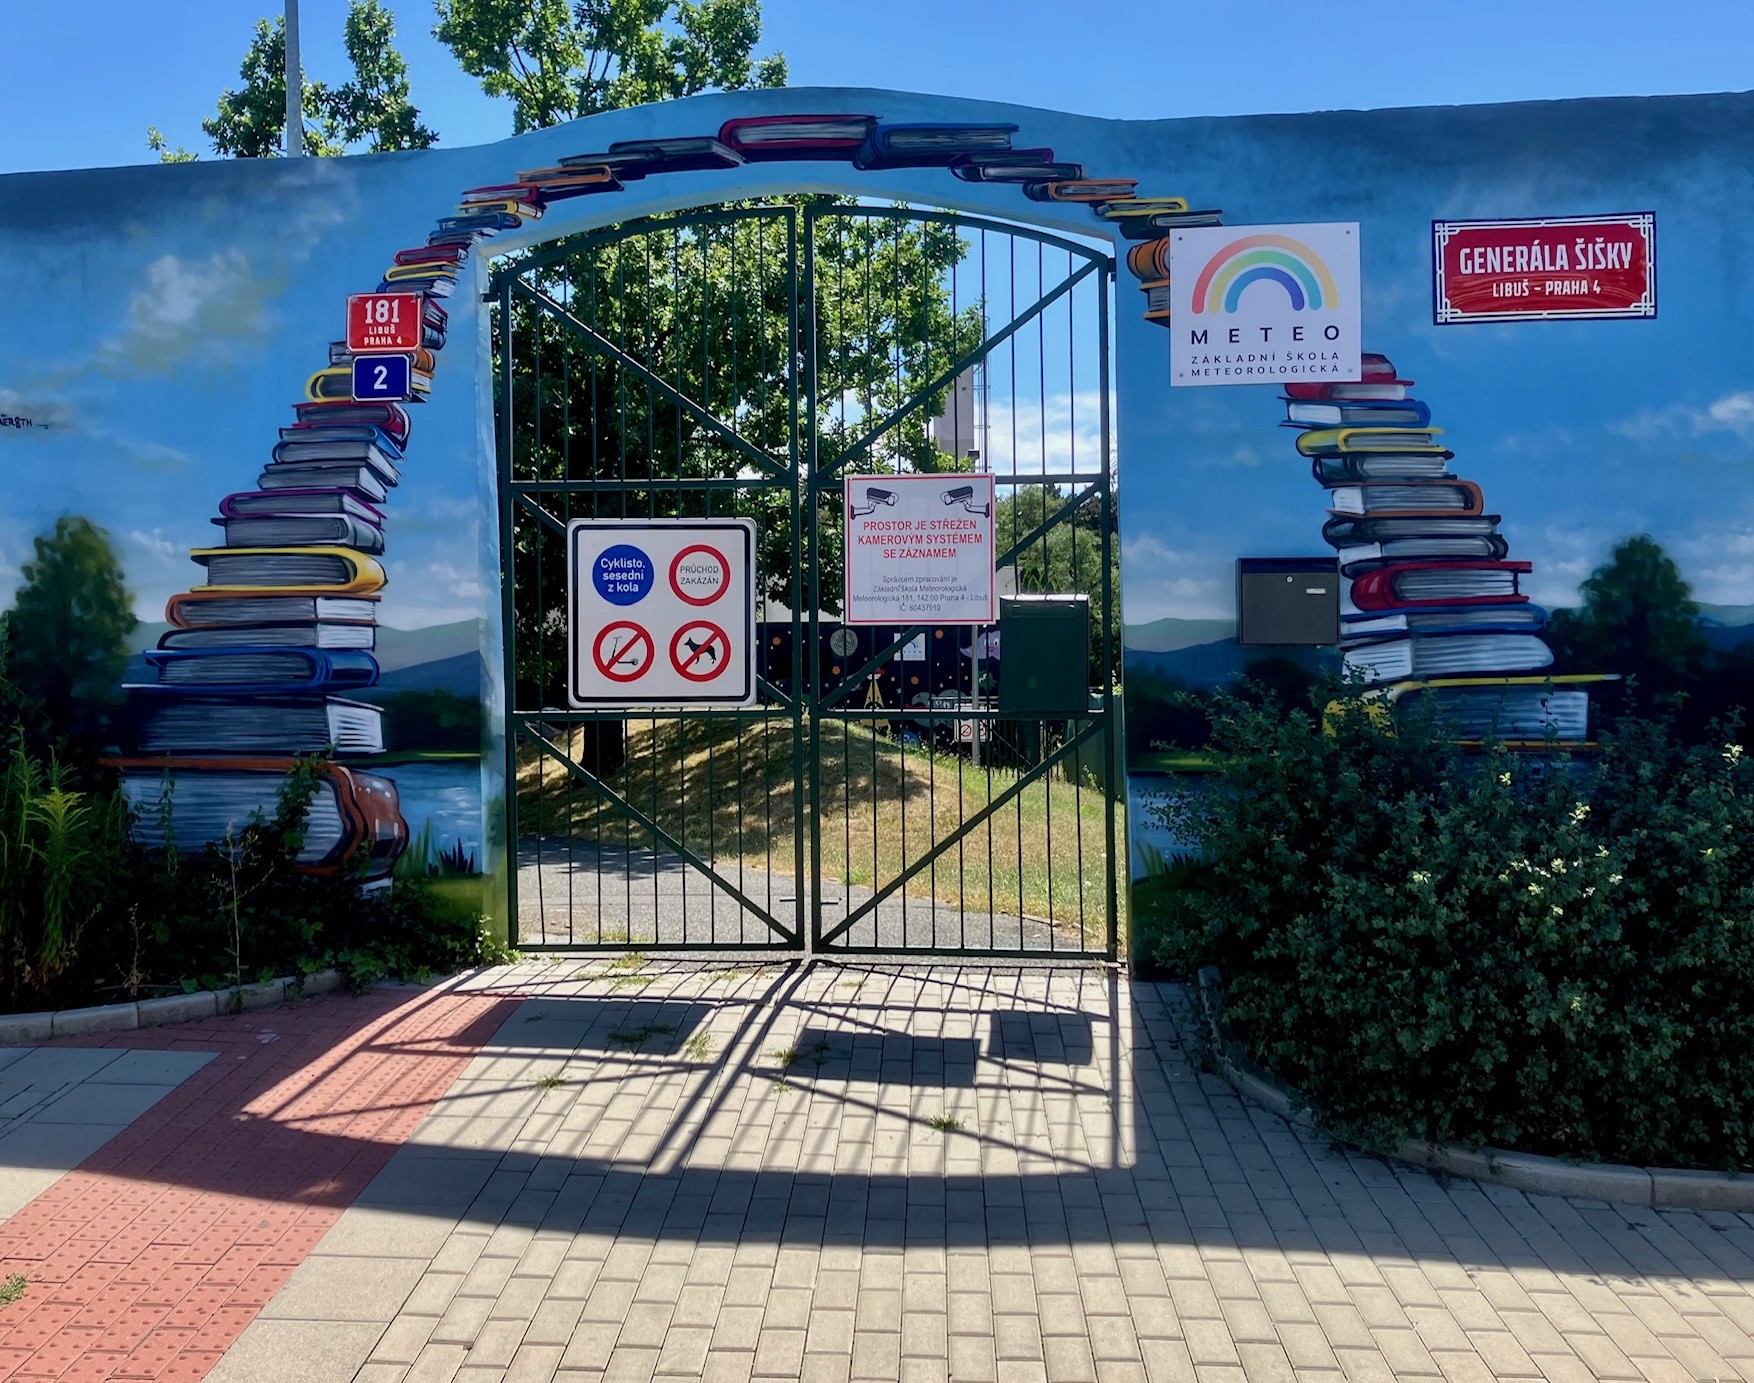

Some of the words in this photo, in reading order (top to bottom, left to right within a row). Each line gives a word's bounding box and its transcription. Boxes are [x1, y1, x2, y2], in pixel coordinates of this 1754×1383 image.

[1459, 240, 1569, 274] GENERÁLA
[1575, 237, 1633, 270] ŠIŠKY
[1492, 279, 1529, 298] LIBUŠ
[1545, 280, 1588, 296] PRAHA
[1593, 279, 1601, 295] 4
[365, 299, 400, 324] 181
[368, 324, 396, 335] LIBUŠ
[1190, 325, 1340, 345] METEO
[363, 336, 393, 346] PRAHA
[397, 336, 402, 344] 4
[1191, 352, 1276, 364] ZÁKLADNÍ
[1286, 351, 1339, 361] ŠKOLA
[1191, 362, 1339, 376] METEOROLOGICKÁ
[373, 365, 388, 390] 2
[863, 521, 912, 531] PROSTOR
[915, 520, 927, 530] JE
[930, 518, 977, 530] STŘEŽEN
[858, 532, 923, 545] KAMEROVÝM
[926, 532, 983, 544] SYSTÉMEM
[883, 549, 897, 558] SE
[899, 547, 957, 558] ZÁZNAMEM
[679, 564, 719, 573] PRŮCHOD
[602, 569, 644, 580] sesedni
[882, 575, 914, 584] Správcem
[915, 575, 951, 584] zpracování
[950, 575, 958, 584] je
[680, 577, 719, 585] ZAKÁZÁN
[608, 584, 614, 592] z
[616, 583, 639, 592] kola
[873, 584, 901, 592] Základní
[901, 584, 918, 592] škola
[919, 584, 967, 593] Meteorologická
[853, 594, 899, 603] Meteorologická
[940, 593, 959, 601] Praha
[971, 593, 988, 601] Libuš
[909, 603, 941, 611] 60437910
